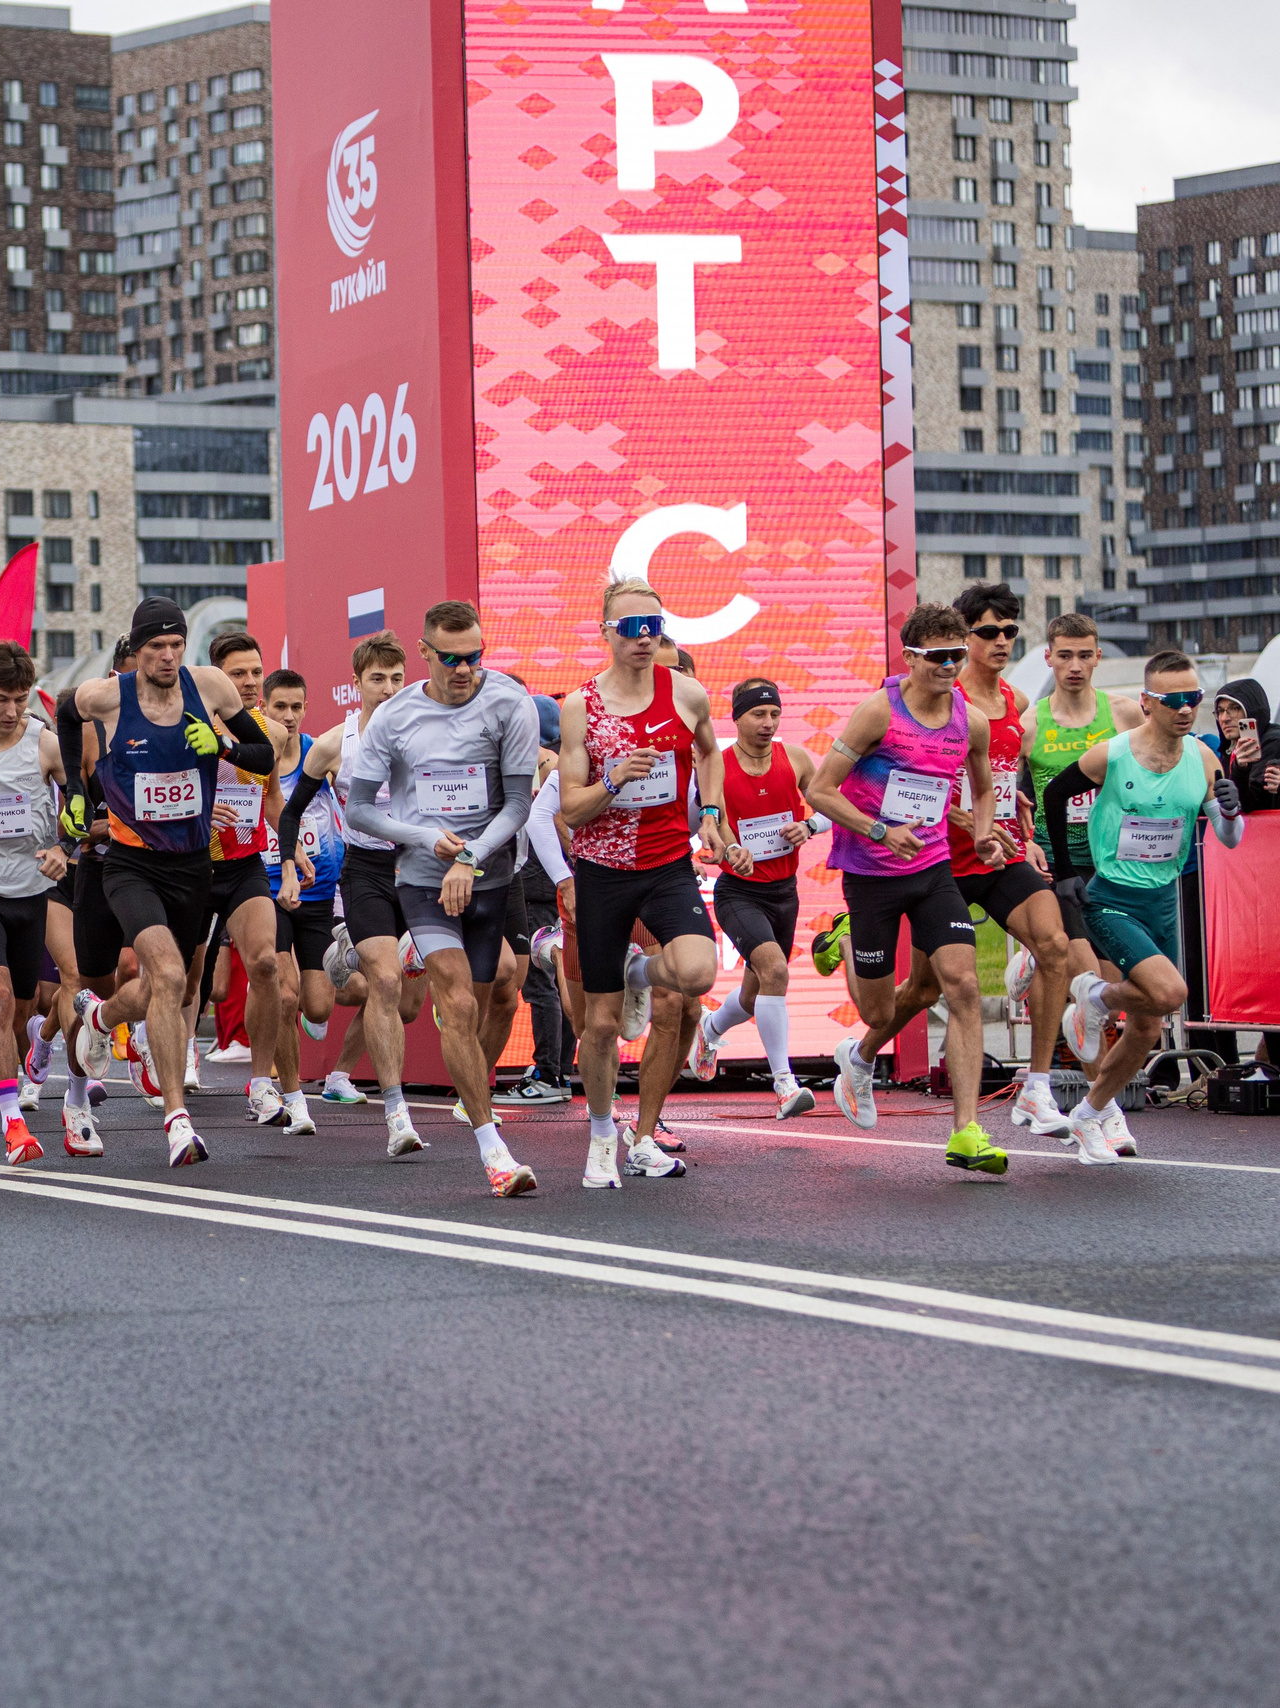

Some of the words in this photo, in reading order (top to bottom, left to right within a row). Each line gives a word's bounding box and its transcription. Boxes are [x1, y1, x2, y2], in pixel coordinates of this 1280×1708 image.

[343, 134, 378, 216] 35
[307, 381, 417, 511] 2026
[1044, 738, 1106, 753] DUCK
[144, 784, 195, 804] 1582
[432, 784, 468, 792] ГУЩИН
[994, 786, 1012, 802] 24
[898, 790, 937, 803] НЕДЕЛИН
[1071, 790, 1092, 807] 81
[1132, 833, 1174, 841] НИКИТИН
[856, 950, 884, 958] HUAWEI
